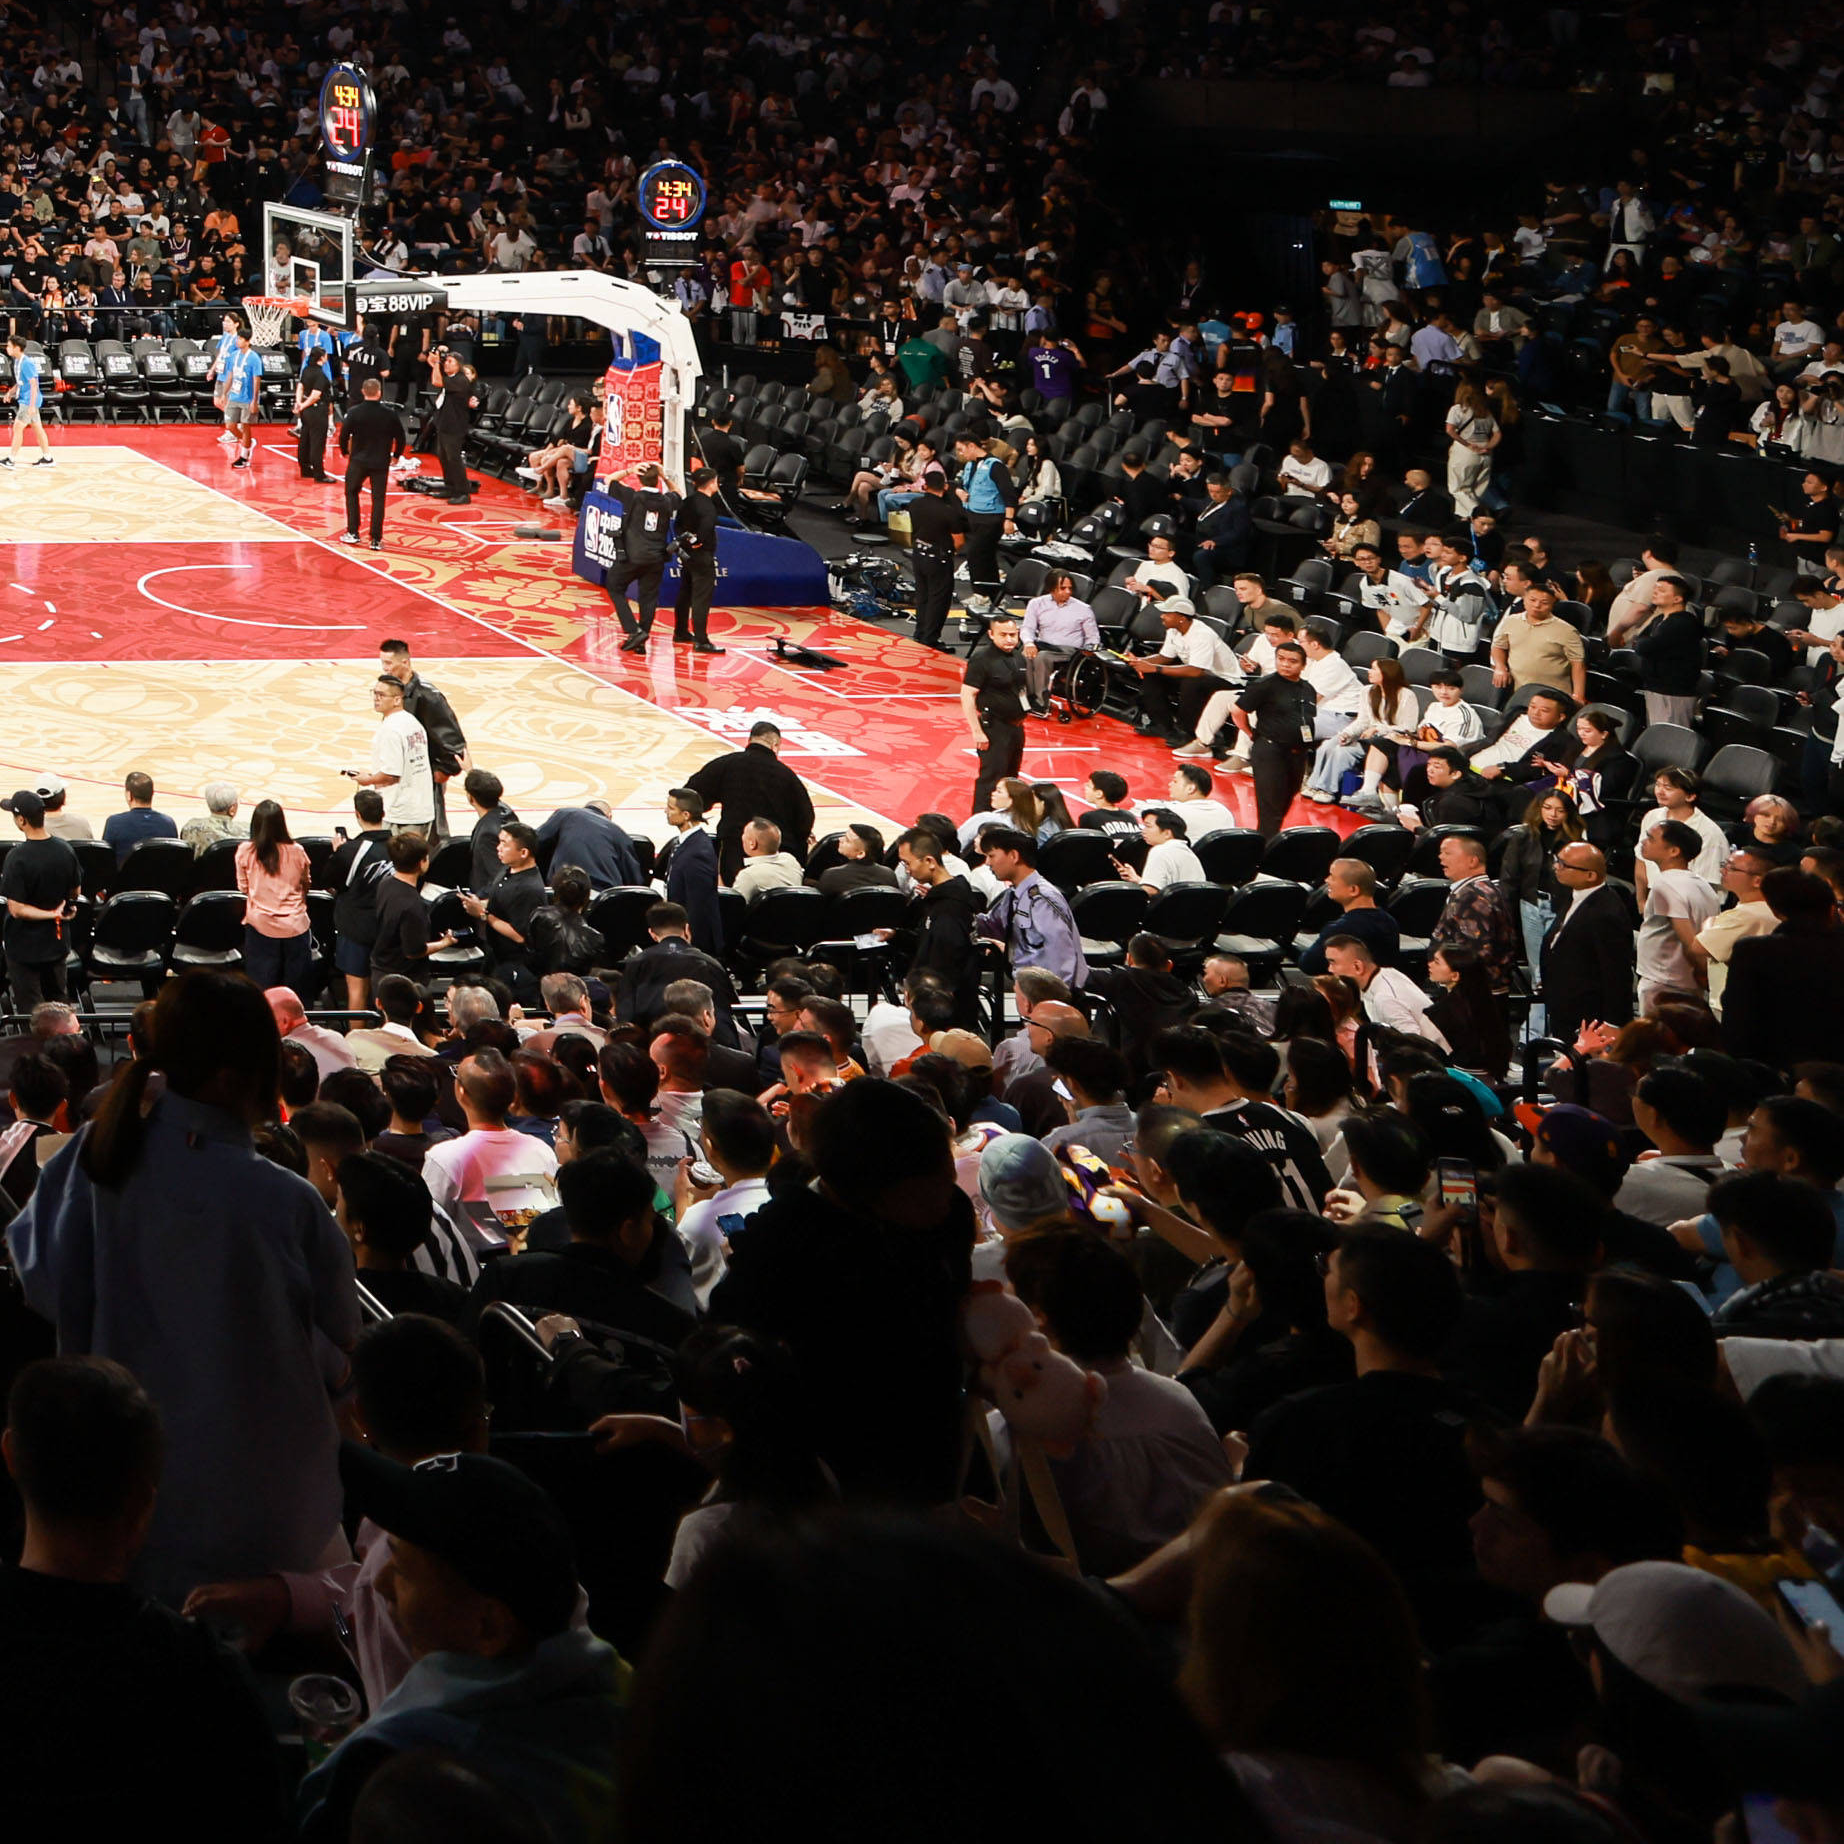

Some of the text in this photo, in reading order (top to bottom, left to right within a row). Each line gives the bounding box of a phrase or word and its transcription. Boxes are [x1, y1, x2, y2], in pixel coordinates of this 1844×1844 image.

[329, 106, 359, 147] 24
[336, 162, 363, 176] TISSOT
[658, 180, 692, 197] 4:34
[654, 198, 687, 219] 24
[662, 232, 698, 241] TISSOT
[1042, 364, 1051, 379] 1
